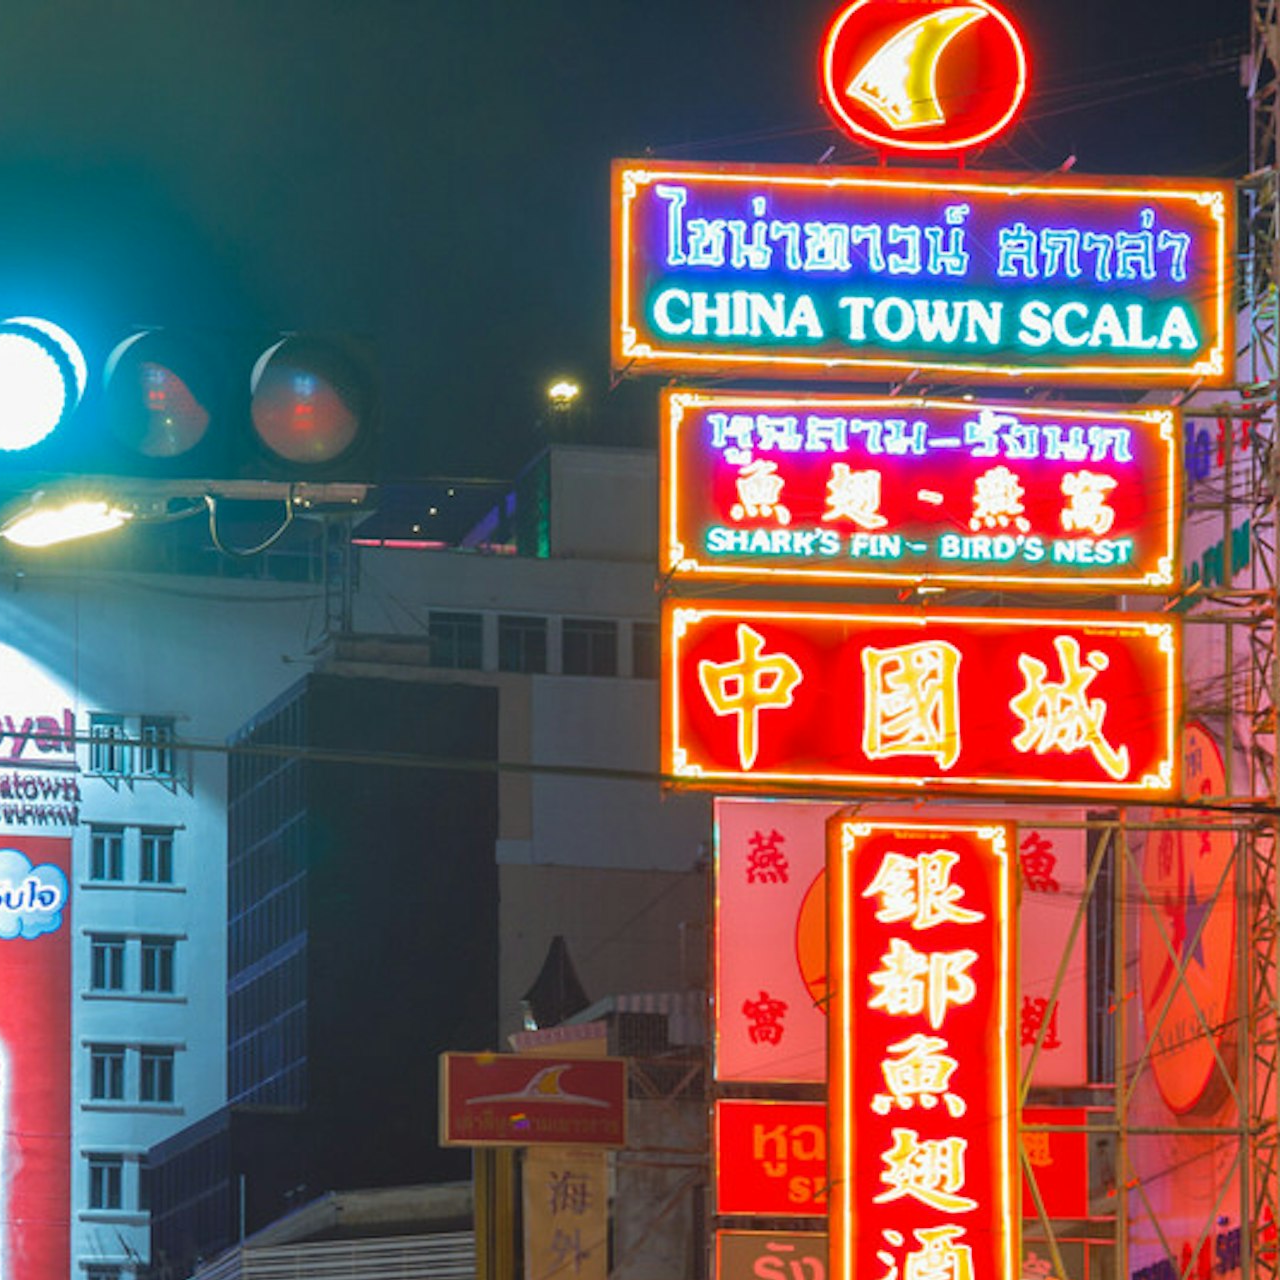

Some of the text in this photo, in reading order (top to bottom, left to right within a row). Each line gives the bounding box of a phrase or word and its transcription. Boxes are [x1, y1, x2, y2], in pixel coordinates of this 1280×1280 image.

[656, 184, 1190, 282] ไชน่าทาวน์ สกาล่า
[654, 288, 1200, 351] CHINA TOWN SCALA
[706, 526, 841, 557] SHARK'S
[850, 530, 902, 558] FIN
[940, 532, 1045, 562] BIRD'S
[1052, 537, 1133, 565] NEST
[698, 622, 1130, 782] 中國城
[742, 829, 789, 1047] 燕窩
